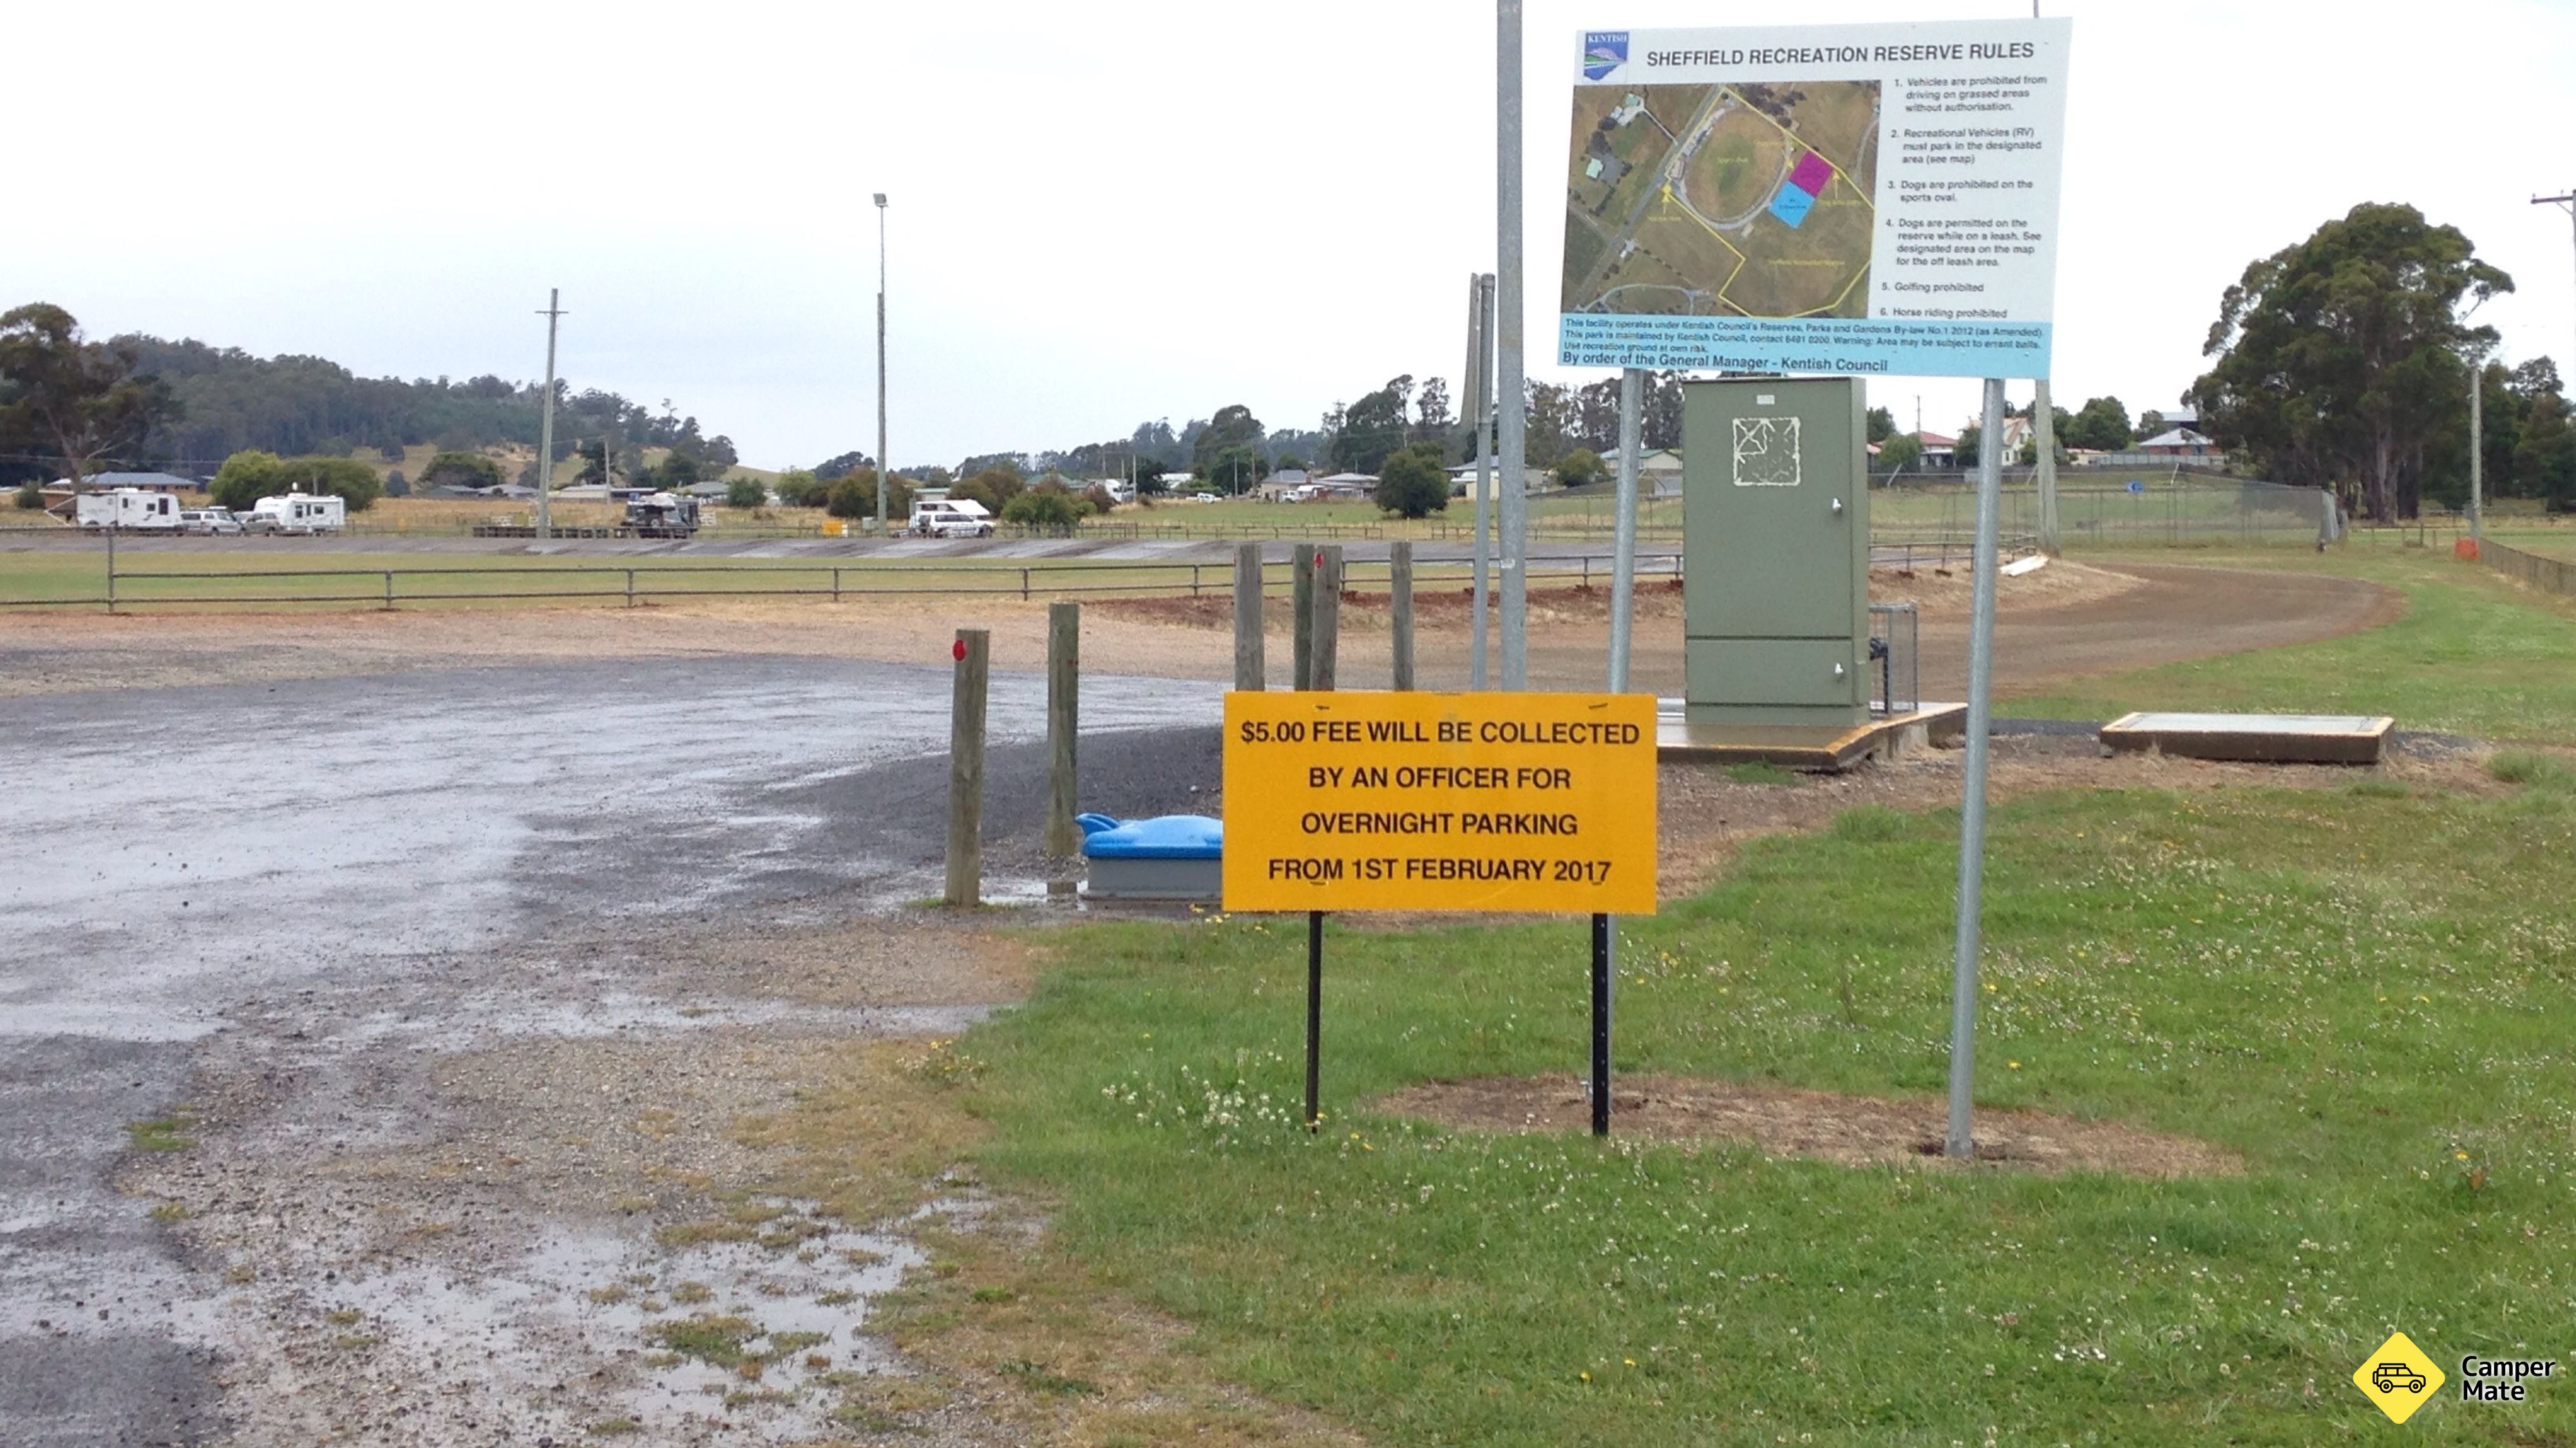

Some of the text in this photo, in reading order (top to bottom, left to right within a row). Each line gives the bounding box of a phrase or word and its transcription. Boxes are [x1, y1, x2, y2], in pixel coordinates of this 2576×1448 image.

[1587, 33, 1627, 43] KENTISH
[1647, 42, 2034, 66] SHEFFIELD RECREATION RESERVE RULES
[1895, 79, 1902, 87] 1.
[1907, 77, 1948, 86] Vehicles
[1969, 76, 2022, 88] prohibited
[2023, 75, 2047, 84] from
[1906, 90, 1940, 100] driving
[1959, 90, 1999, 101] grassed
[1905, 103, 2013, 112] without authorisation.
[1891, 128, 2034, 138] 2. Recreational Vehicles (RV)
[1930, 142, 1952, 152] park
[1985, 141, 2041, 151] designated
[1926, 155, 1947, 164] (see
[1949, 155, 1975, 164] map)
[1900, 180, 1926, 191] Dogs
[1947, 180, 1998, 191] prohibited
[1900, 193, 1957, 204] sports oval.
[1886, 218, 1893, 227] 4.
[1899, 218, 1924, 229] Dogs
[1945, 219, 1993, 229] permitted
[1937, 232, 1963, 240] while
[1990, 232, 2019, 240] leash.
[2022, 232, 2041, 241] See
[1897, 245, 1951, 254] designated
[1994, 245, 2011, 253] the
[2012, 246, 2034, 256] map
[1897, 257, 1909, 265] for
[1947, 258, 1973, 266] leash
[1895, 283, 1931, 293] Golfing
[1933, 283, 1984, 293] prohibited
[1880, 308, 2008, 319] 6. Horse riding prohibited
[1566, 319, 1583, 327] This
[1586, 319, 1614, 329] facility
[1616, 321, 1653, 330] operates
[1682, 321, 1715, 330] Kentish
[1806, 324, 1832, 333] Parks
[1853, 325, 1891, 334] Gardens
[1894, 326, 1925, 336] By-law
[1951, 327, 1973, 336] 2012
[1975, 327, 1990, 336] (as
[1565, 330, 1582, 339] This
[1585, 332, 1604, 341] park
[1616, 332, 1662, 340] maintained
[1664, 333, 1674, 342] by
[1677, 333, 1710, 341] Kentish
[1712, 334, 1748, 343] Council,
[1750, 335, 1783, 343] contact
[1877, 338, 1897, 347] Area
[1900, 339, 1918, 348] may
[1922, 338, 1933, 347] be
[1937, 339, 1970, 349] subject
[1582, 343, 1625, 352] recreation
[1627, 344, 1657, 353] ground
[1563, 352, 1578, 365] By
[1582, 352, 1615, 365] order
[1619, 353, 1633, 365] of
[1635, 354, 1655, 365] the
[1659, 354, 1709, 367] General
[1712, 356, 1769, 370] Manager
[1781, 357, 1832, 371] Kentish
[1835, 358, 1888, 372] Council
[1240, 721, 1640, 745] $5.00 FEE WILL BE COLLECTED
[1309, 767, 1571, 790] BY AN OFFICER FOR
[1300, 812, 1578, 835] OVERNIGHT PARKING
[1268, 858, 1612, 882] FROM 1ST FEBRUARY 2017
